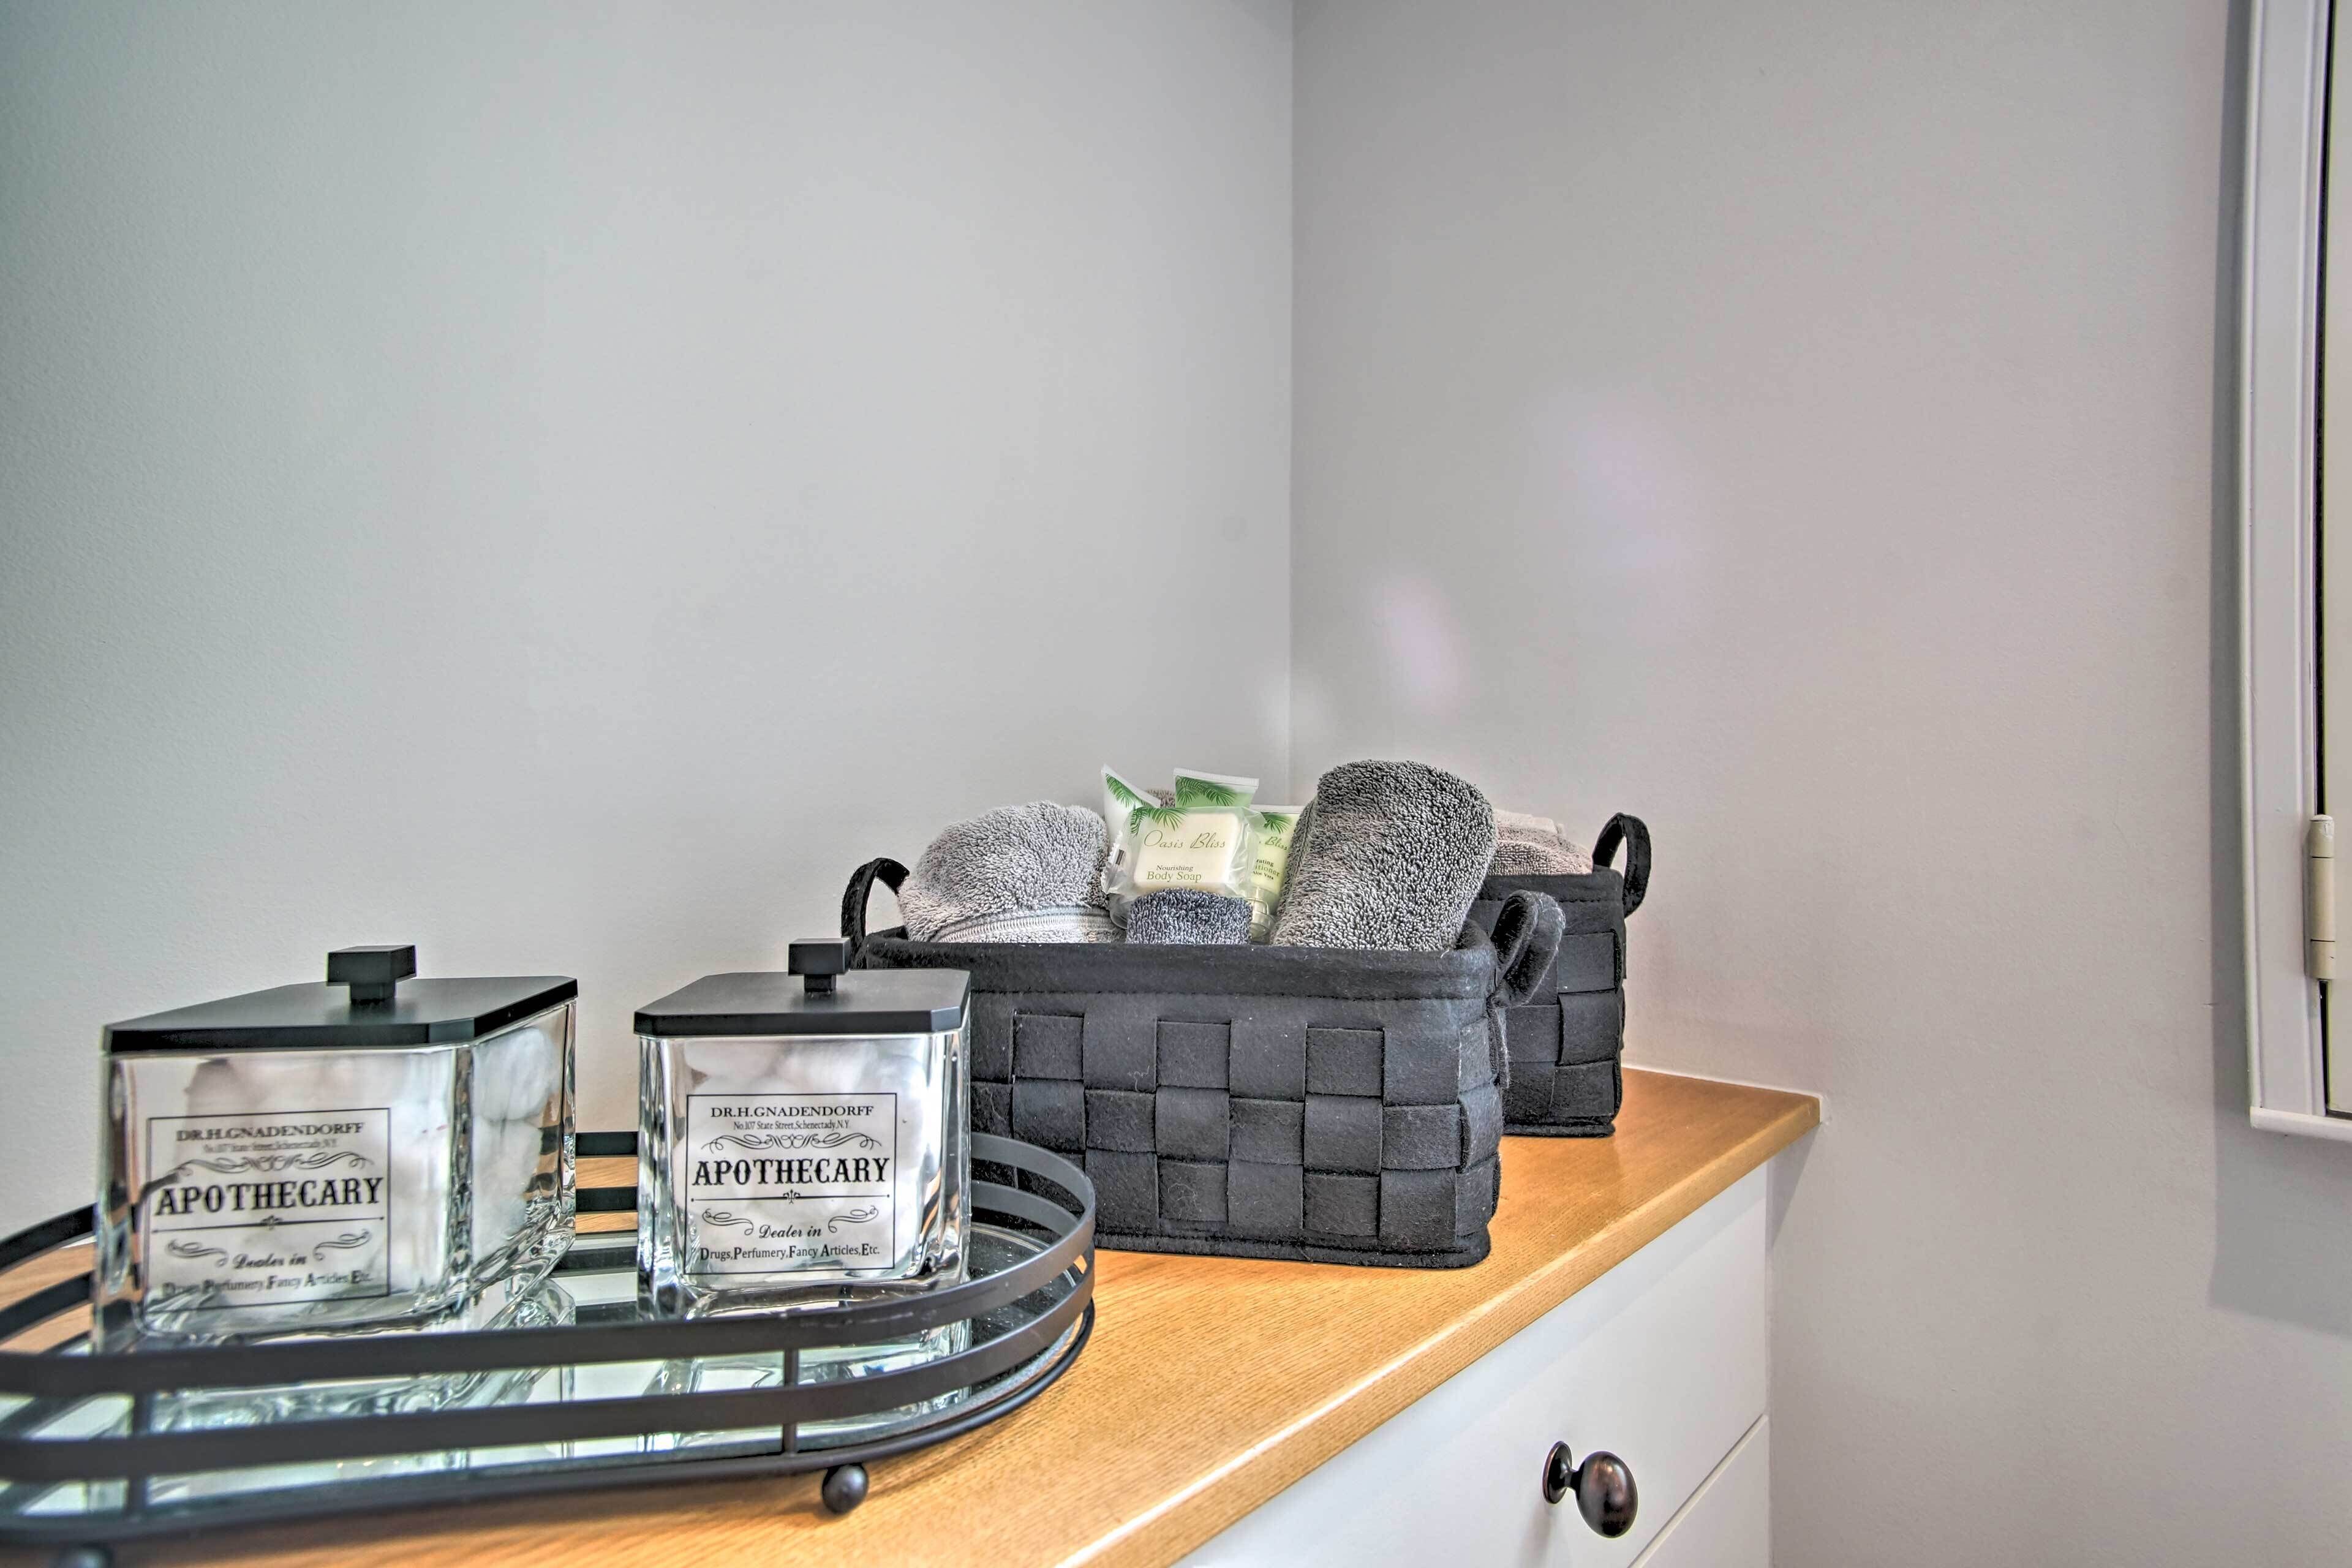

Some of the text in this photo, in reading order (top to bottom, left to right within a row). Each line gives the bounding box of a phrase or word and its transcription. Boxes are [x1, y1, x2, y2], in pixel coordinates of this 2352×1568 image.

[1144, 830, 1225, 849] Oasis Bliss
[1265, 836, 1287, 851] Bliss
[1255, 864, 1280, 876] itioner
[1256, 859, 1274, 867] rating
[1147, 871, 1202, 883] Body Soap
[757, 1121, 773, 1129] State
[692, 1157, 890, 1186] APOTHECARY
[154, 1176, 384, 1216] APOTHECARY
[759, 1224, 822, 1238] Dealer in
[233, 1253, 307, 1269] Dealer in
